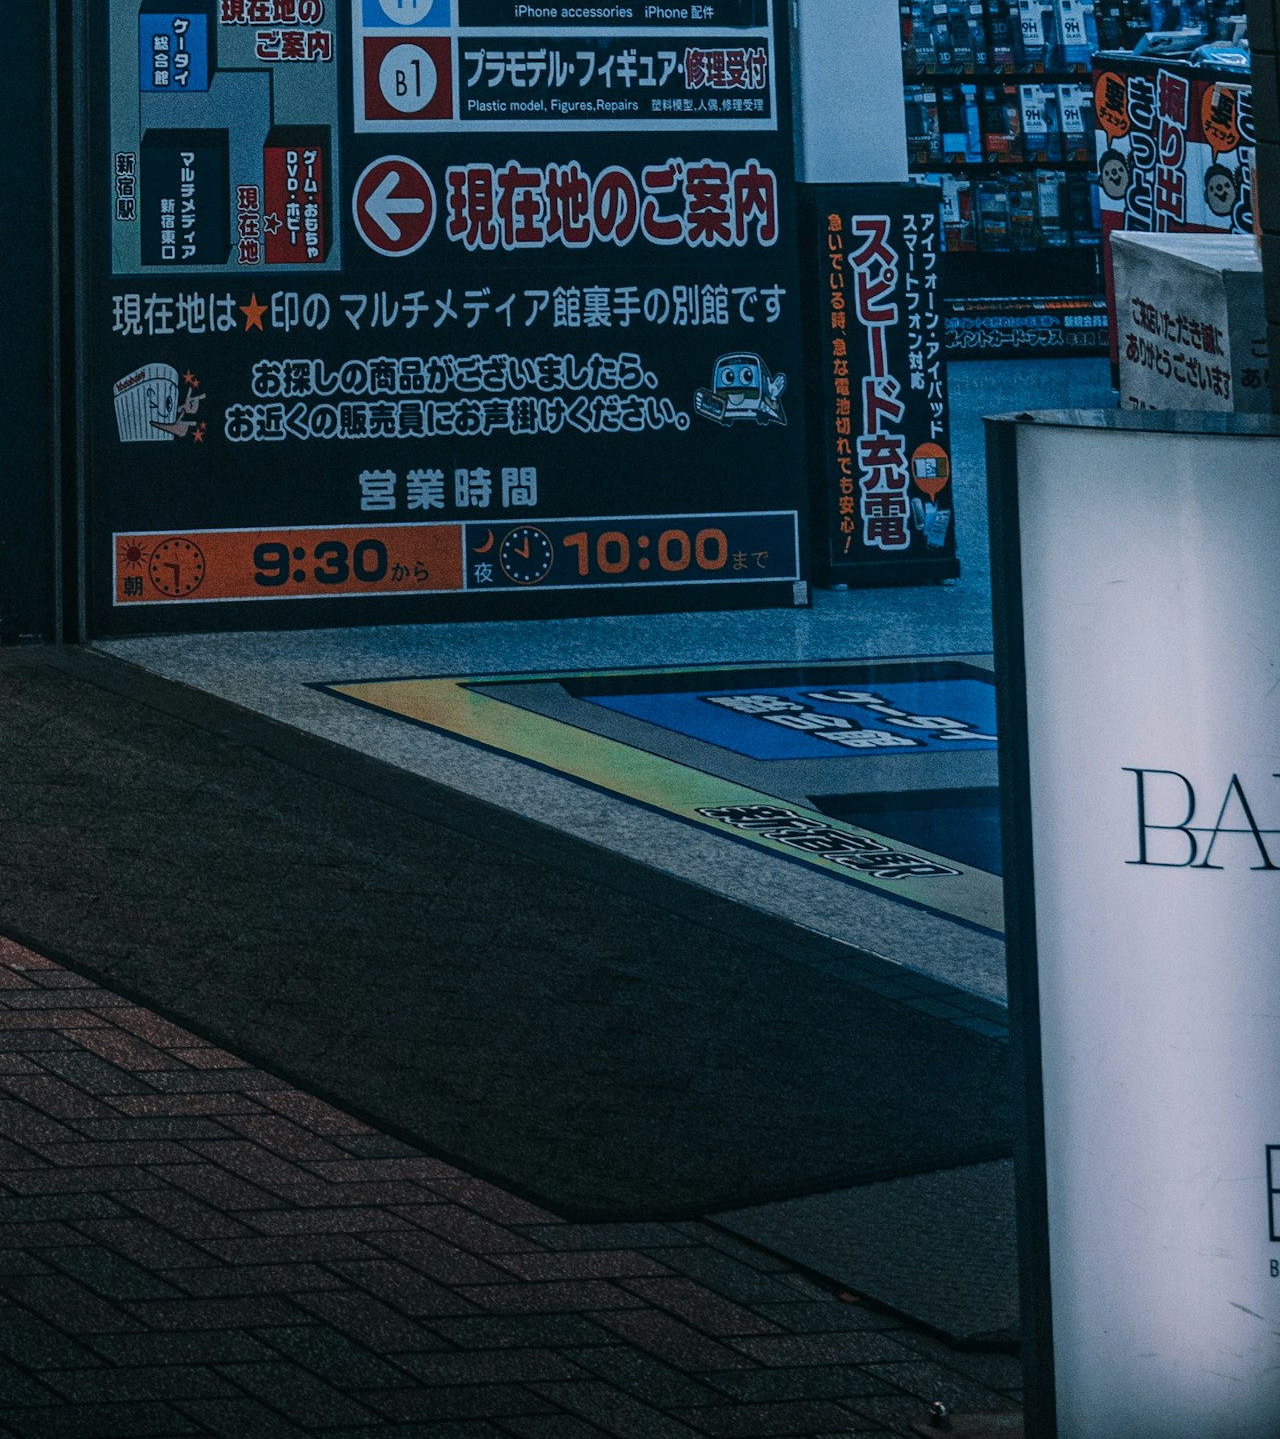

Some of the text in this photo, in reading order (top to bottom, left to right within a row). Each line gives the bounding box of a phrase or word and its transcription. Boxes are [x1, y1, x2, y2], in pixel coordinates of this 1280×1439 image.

[514, 4, 634, 19] iPhone accessories
[645, 4, 715, 21] iPhone 配件
[1064, 20, 1080, 34] 9H
[153, 35, 170, 86] 総合館
[173, 18, 190, 86] ケータイ
[255, 29, 333, 63] ご案内
[463, 47, 767, 90] プラモデル・フィギュア・修理受付
[394, 58, 422, 97] B1
[467, 98, 547, 113] Plastic model,
[1063, 108, 1080, 122] 9H
[1098, 106, 1129, 131] チェック
[1204, 120, 1237, 145] チェック
[115, 151, 137, 222] 新宿駅
[180, 151, 196, 260] マルチメディア
[286, 150, 301, 246] DVD・ホビー
[302, 150, 320, 259] ゲーム・おもちゃ
[445, 156, 779, 251] 現在地のご案内
[160, 198, 176, 260] 新宿東口
[237, 184, 261, 265] 現在地
[902, 213, 926, 391] スマートフォン対応
[920, 212, 945, 441] アイフォーン・アイパッド
[250, 352, 660, 398] お探しの商品がございましたら、
[847, 214, 910, 551] スピード充電
[223, 392, 691, 442] お近くの販売員にお声掛けください。
[358, 466, 539, 512] 営業時間
[123, 575, 144, 597] 朝
[472, 561, 494, 584] 夜
[705, 694, 919, 749] 総合館
[695, 804, 965, 880] 新宿駅
